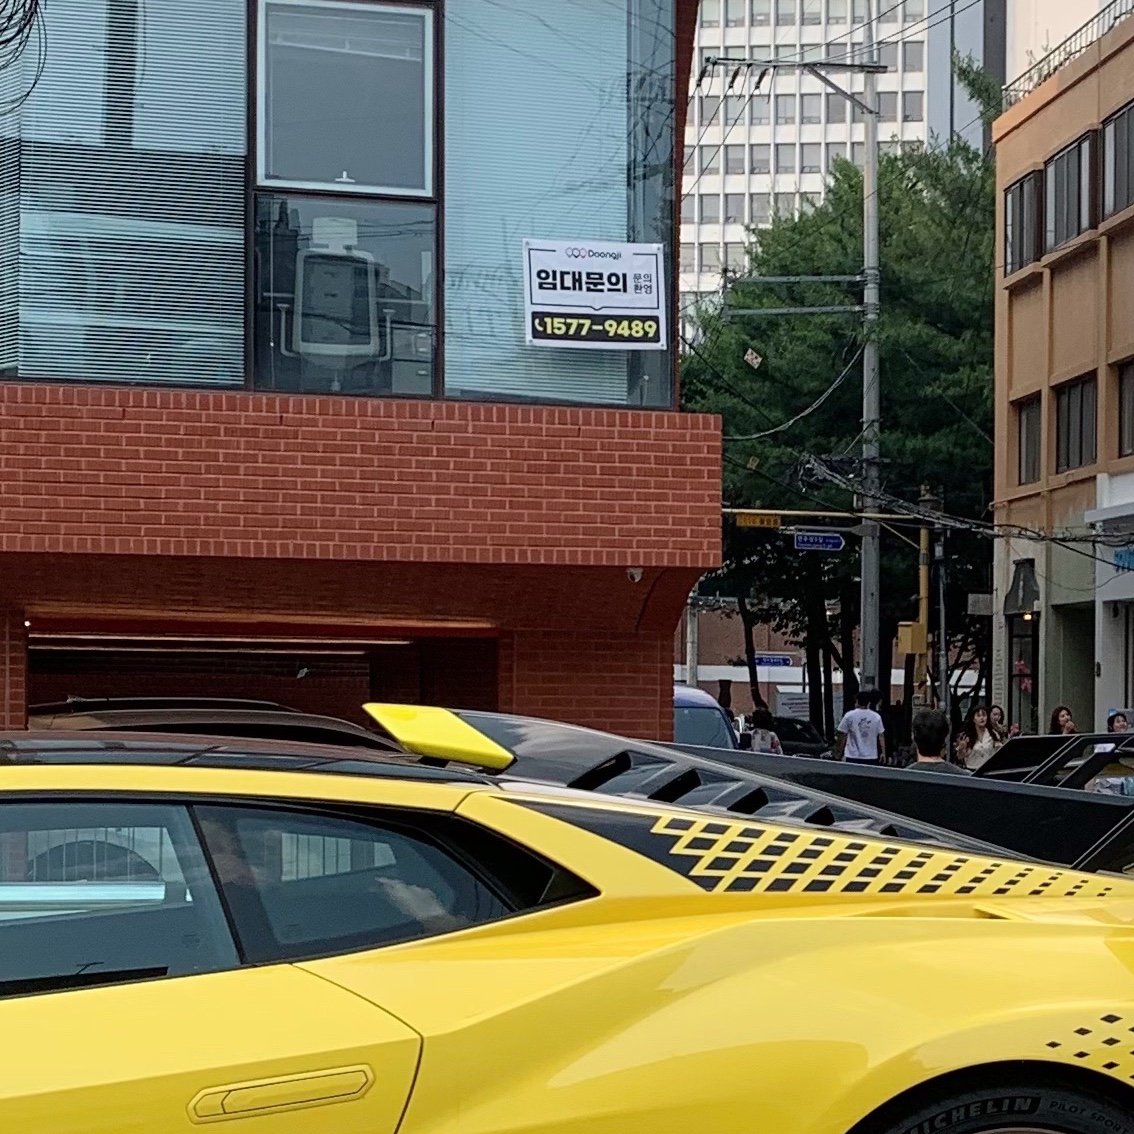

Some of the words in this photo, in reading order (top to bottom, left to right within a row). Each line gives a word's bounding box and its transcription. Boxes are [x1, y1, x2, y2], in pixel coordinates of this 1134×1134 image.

[588, 250, 622, 260] Doongji
[536, 269, 627, 293] 임대문의
[544, 317, 657, 338] 1577-9489
[1050, 1101, 1086, 1114] PILOT
[1091, 1112, 1128, 1134] SPORT
